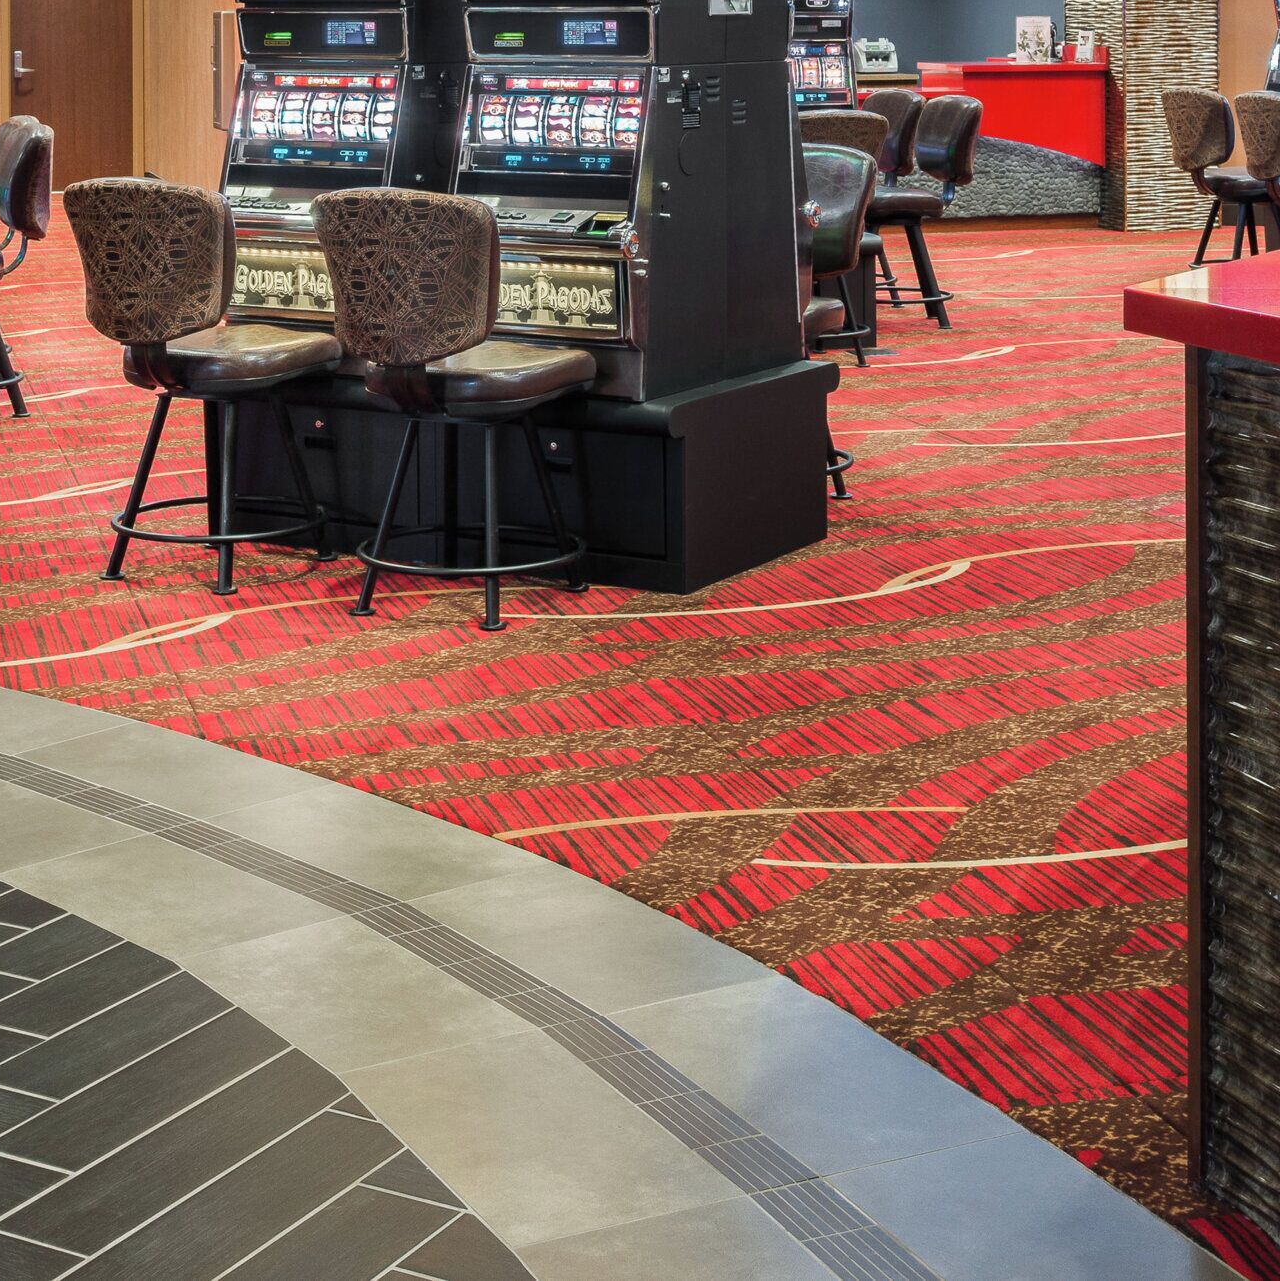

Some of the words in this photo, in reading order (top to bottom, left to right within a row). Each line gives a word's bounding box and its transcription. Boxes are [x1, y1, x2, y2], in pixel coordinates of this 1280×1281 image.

[235, 262, 293, 293] GOLDEN
[499, 284, 531, 311] DEN
[535, 284, 613, 313] PAGODAS
